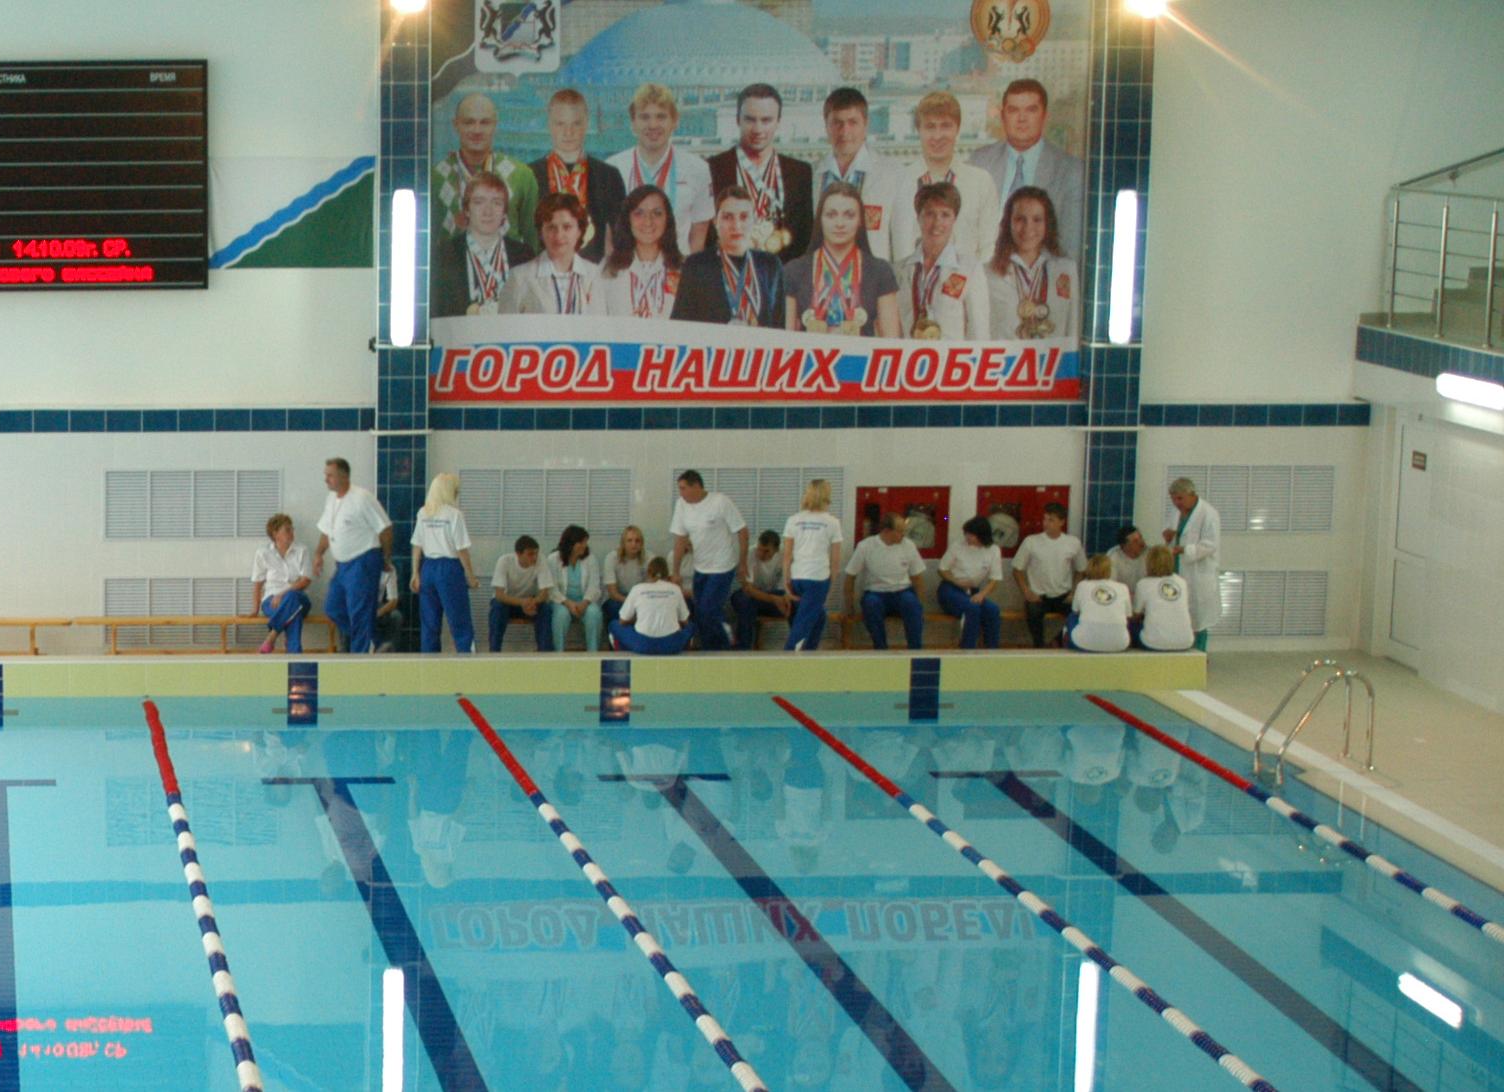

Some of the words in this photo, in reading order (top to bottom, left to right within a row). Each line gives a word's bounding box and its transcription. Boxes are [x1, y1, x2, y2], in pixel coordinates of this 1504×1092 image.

[149, 71, 177, 82] ВРЕМЯ
[435, 346, 613, 392] ГОРОД
[633, 346, 841, 392] НАШИХ
[861, 345, 1061, 391] ПОБЕД!
